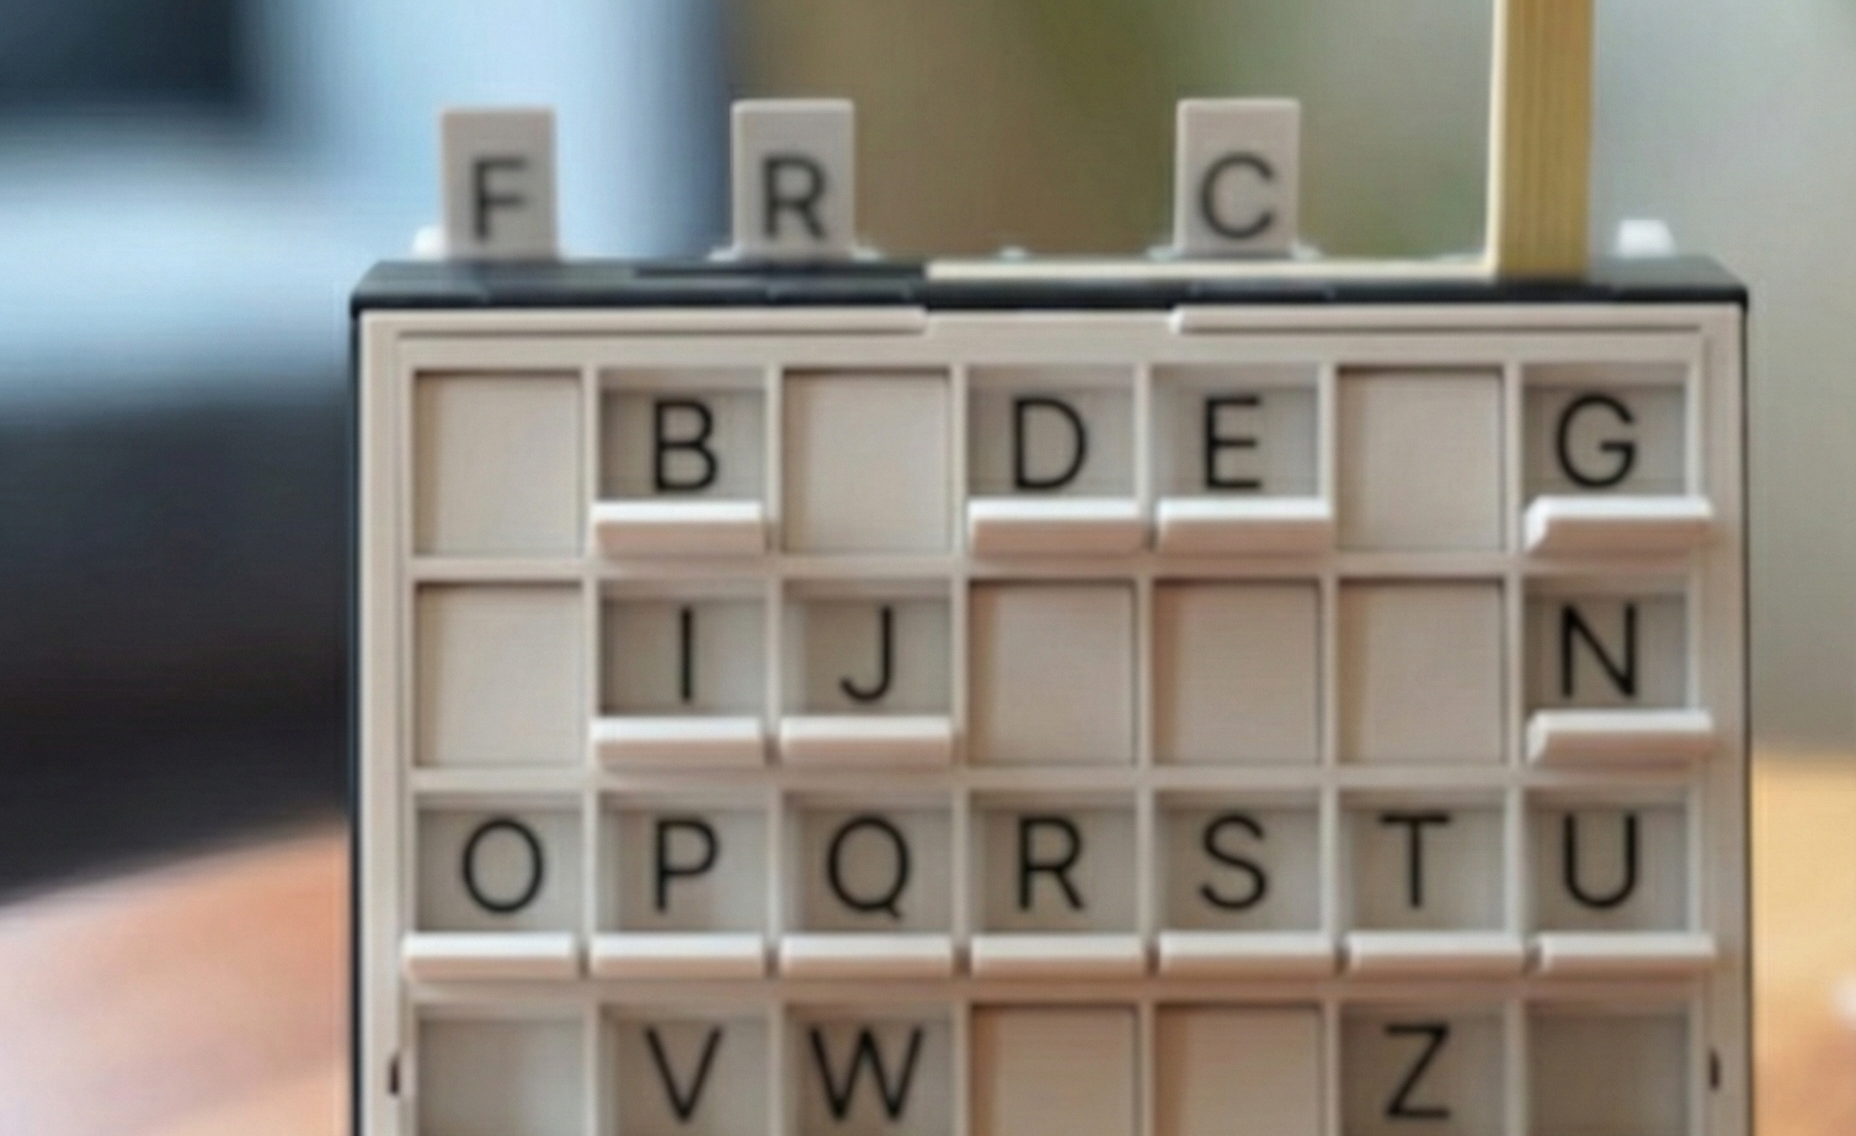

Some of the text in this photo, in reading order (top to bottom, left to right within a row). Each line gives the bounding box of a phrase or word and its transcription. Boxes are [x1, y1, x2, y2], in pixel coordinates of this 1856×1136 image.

[472, 153, 1275, 242] F R C
[652, 389, 1636, 494] B D E G
[840, 604, 895, 704] J
[1560, 603, 1637, 697] N
[460, 809, 1638, 918] O P Q R S T U
[643, 1022, 1449, 1123] V W Z
